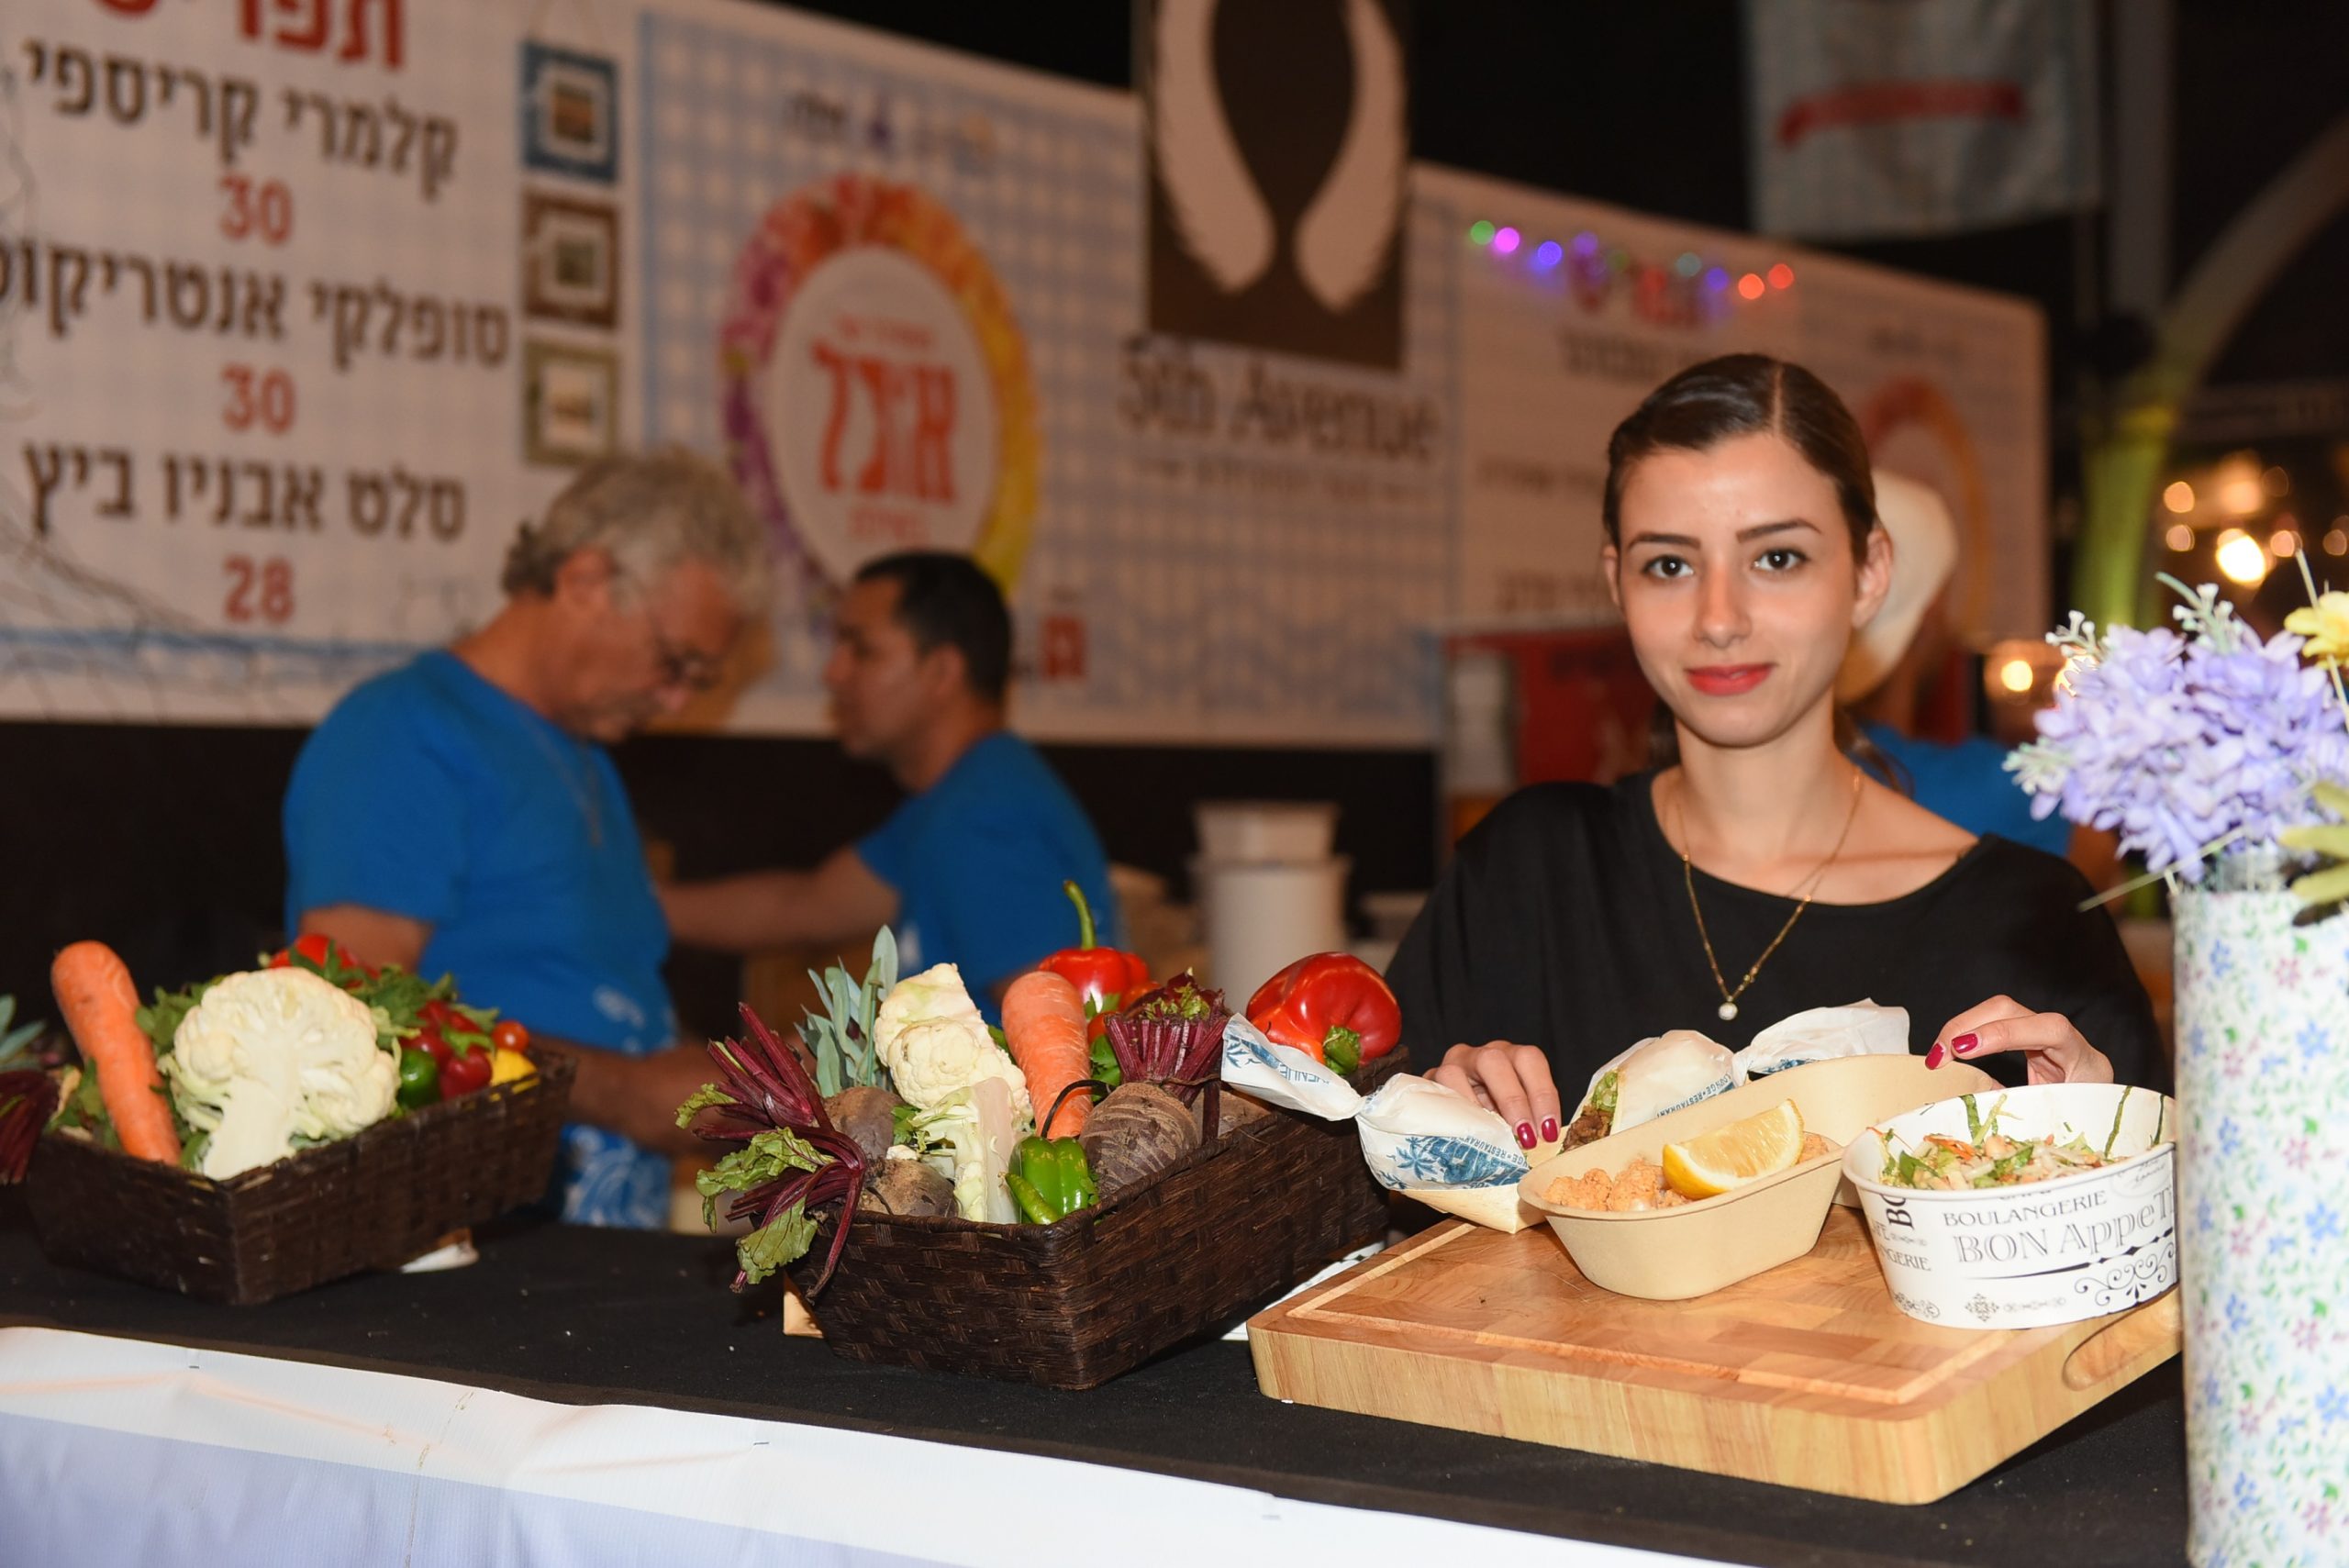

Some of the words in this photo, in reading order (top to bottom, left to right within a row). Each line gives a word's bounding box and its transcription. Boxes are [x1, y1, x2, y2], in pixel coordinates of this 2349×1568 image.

[21, 38, 261, 165] קריספי
[281, 88, 459, 202] קלמרי
[219, 175, 292, 246] 30
[0, 236, 286, 338] אנטריקו
[308, 278, 510, 371] סופלקי
[221, 365, 295, 436] 30
[23, 440, 136, 539] ביץ
[161, 452, 326, 531] אבניו
[346, 464, 466, 540] סלט
[223, 556, 295, 625] 28
[1461, 1136, 1507, 1160] RESTAURAN
[1943, 1190, 2107, 1227] BOULANGERIE
[1953, 1229, 2049, 1262] BON
